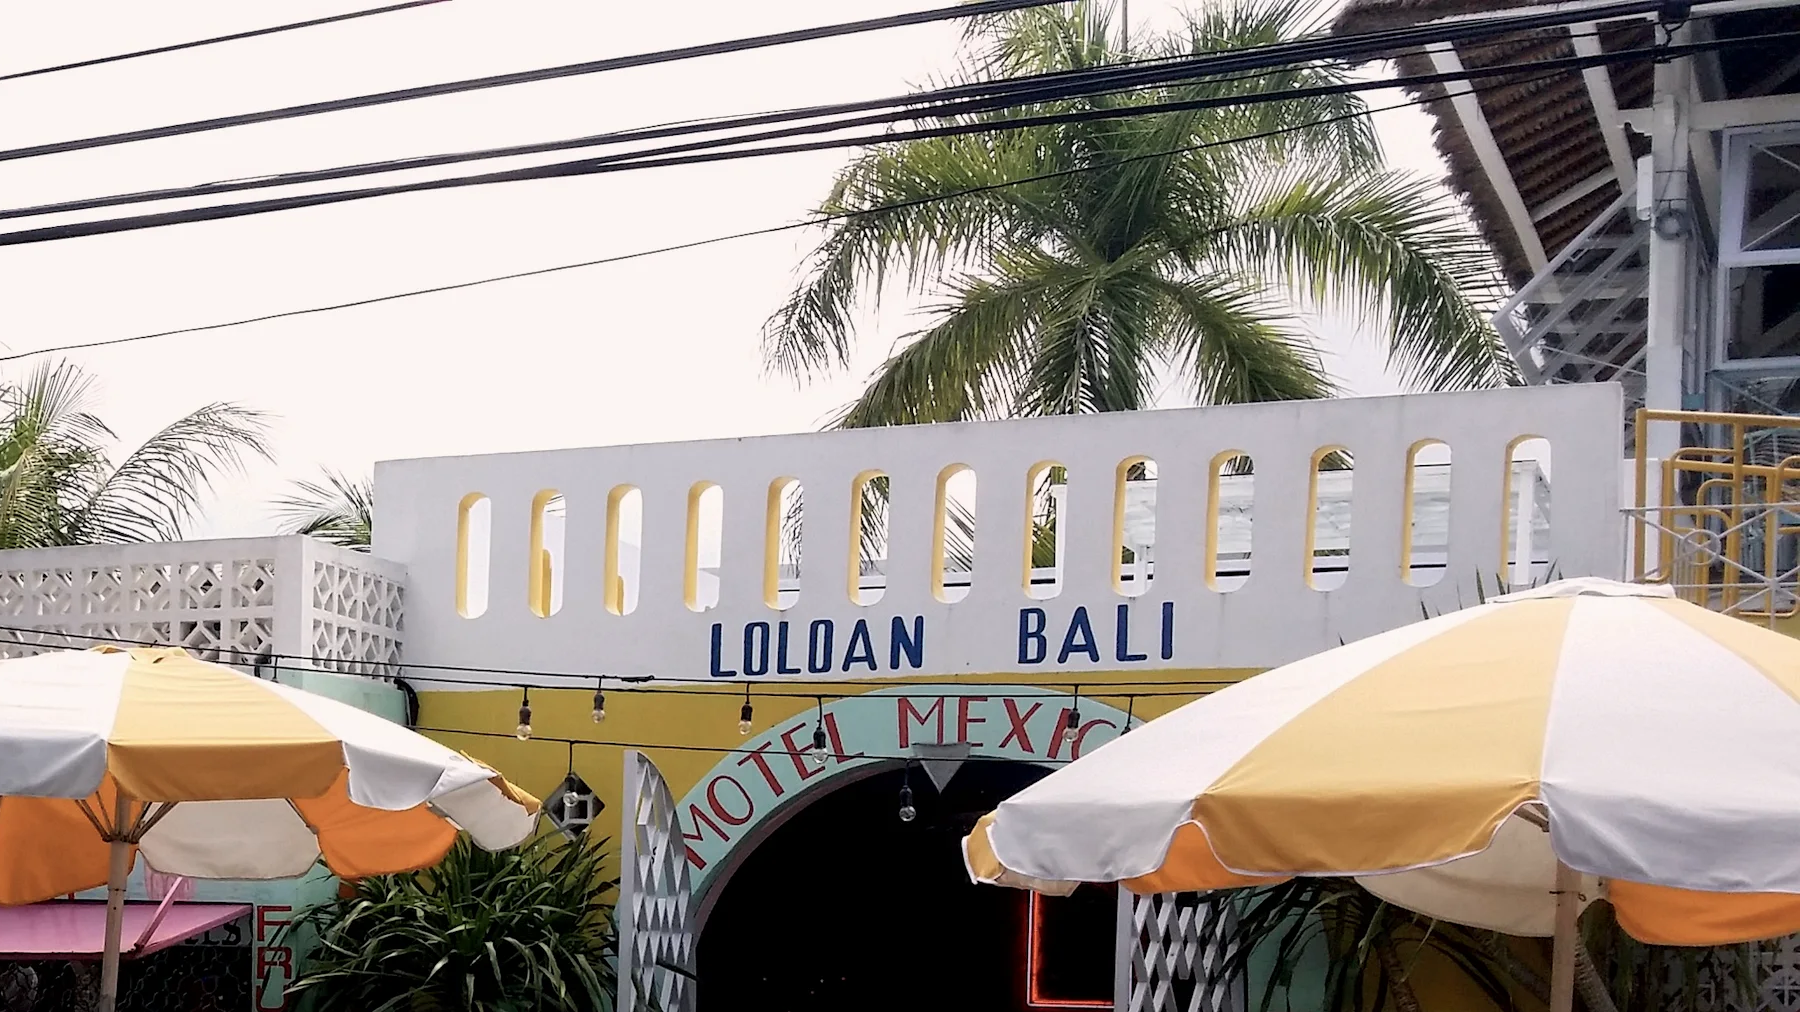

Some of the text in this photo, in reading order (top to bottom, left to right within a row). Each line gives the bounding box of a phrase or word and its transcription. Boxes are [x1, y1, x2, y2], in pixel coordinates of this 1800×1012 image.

[710, 601, 1174, 677] LOLOAN BALI
[682, 712, 865, 870] MOTEL
